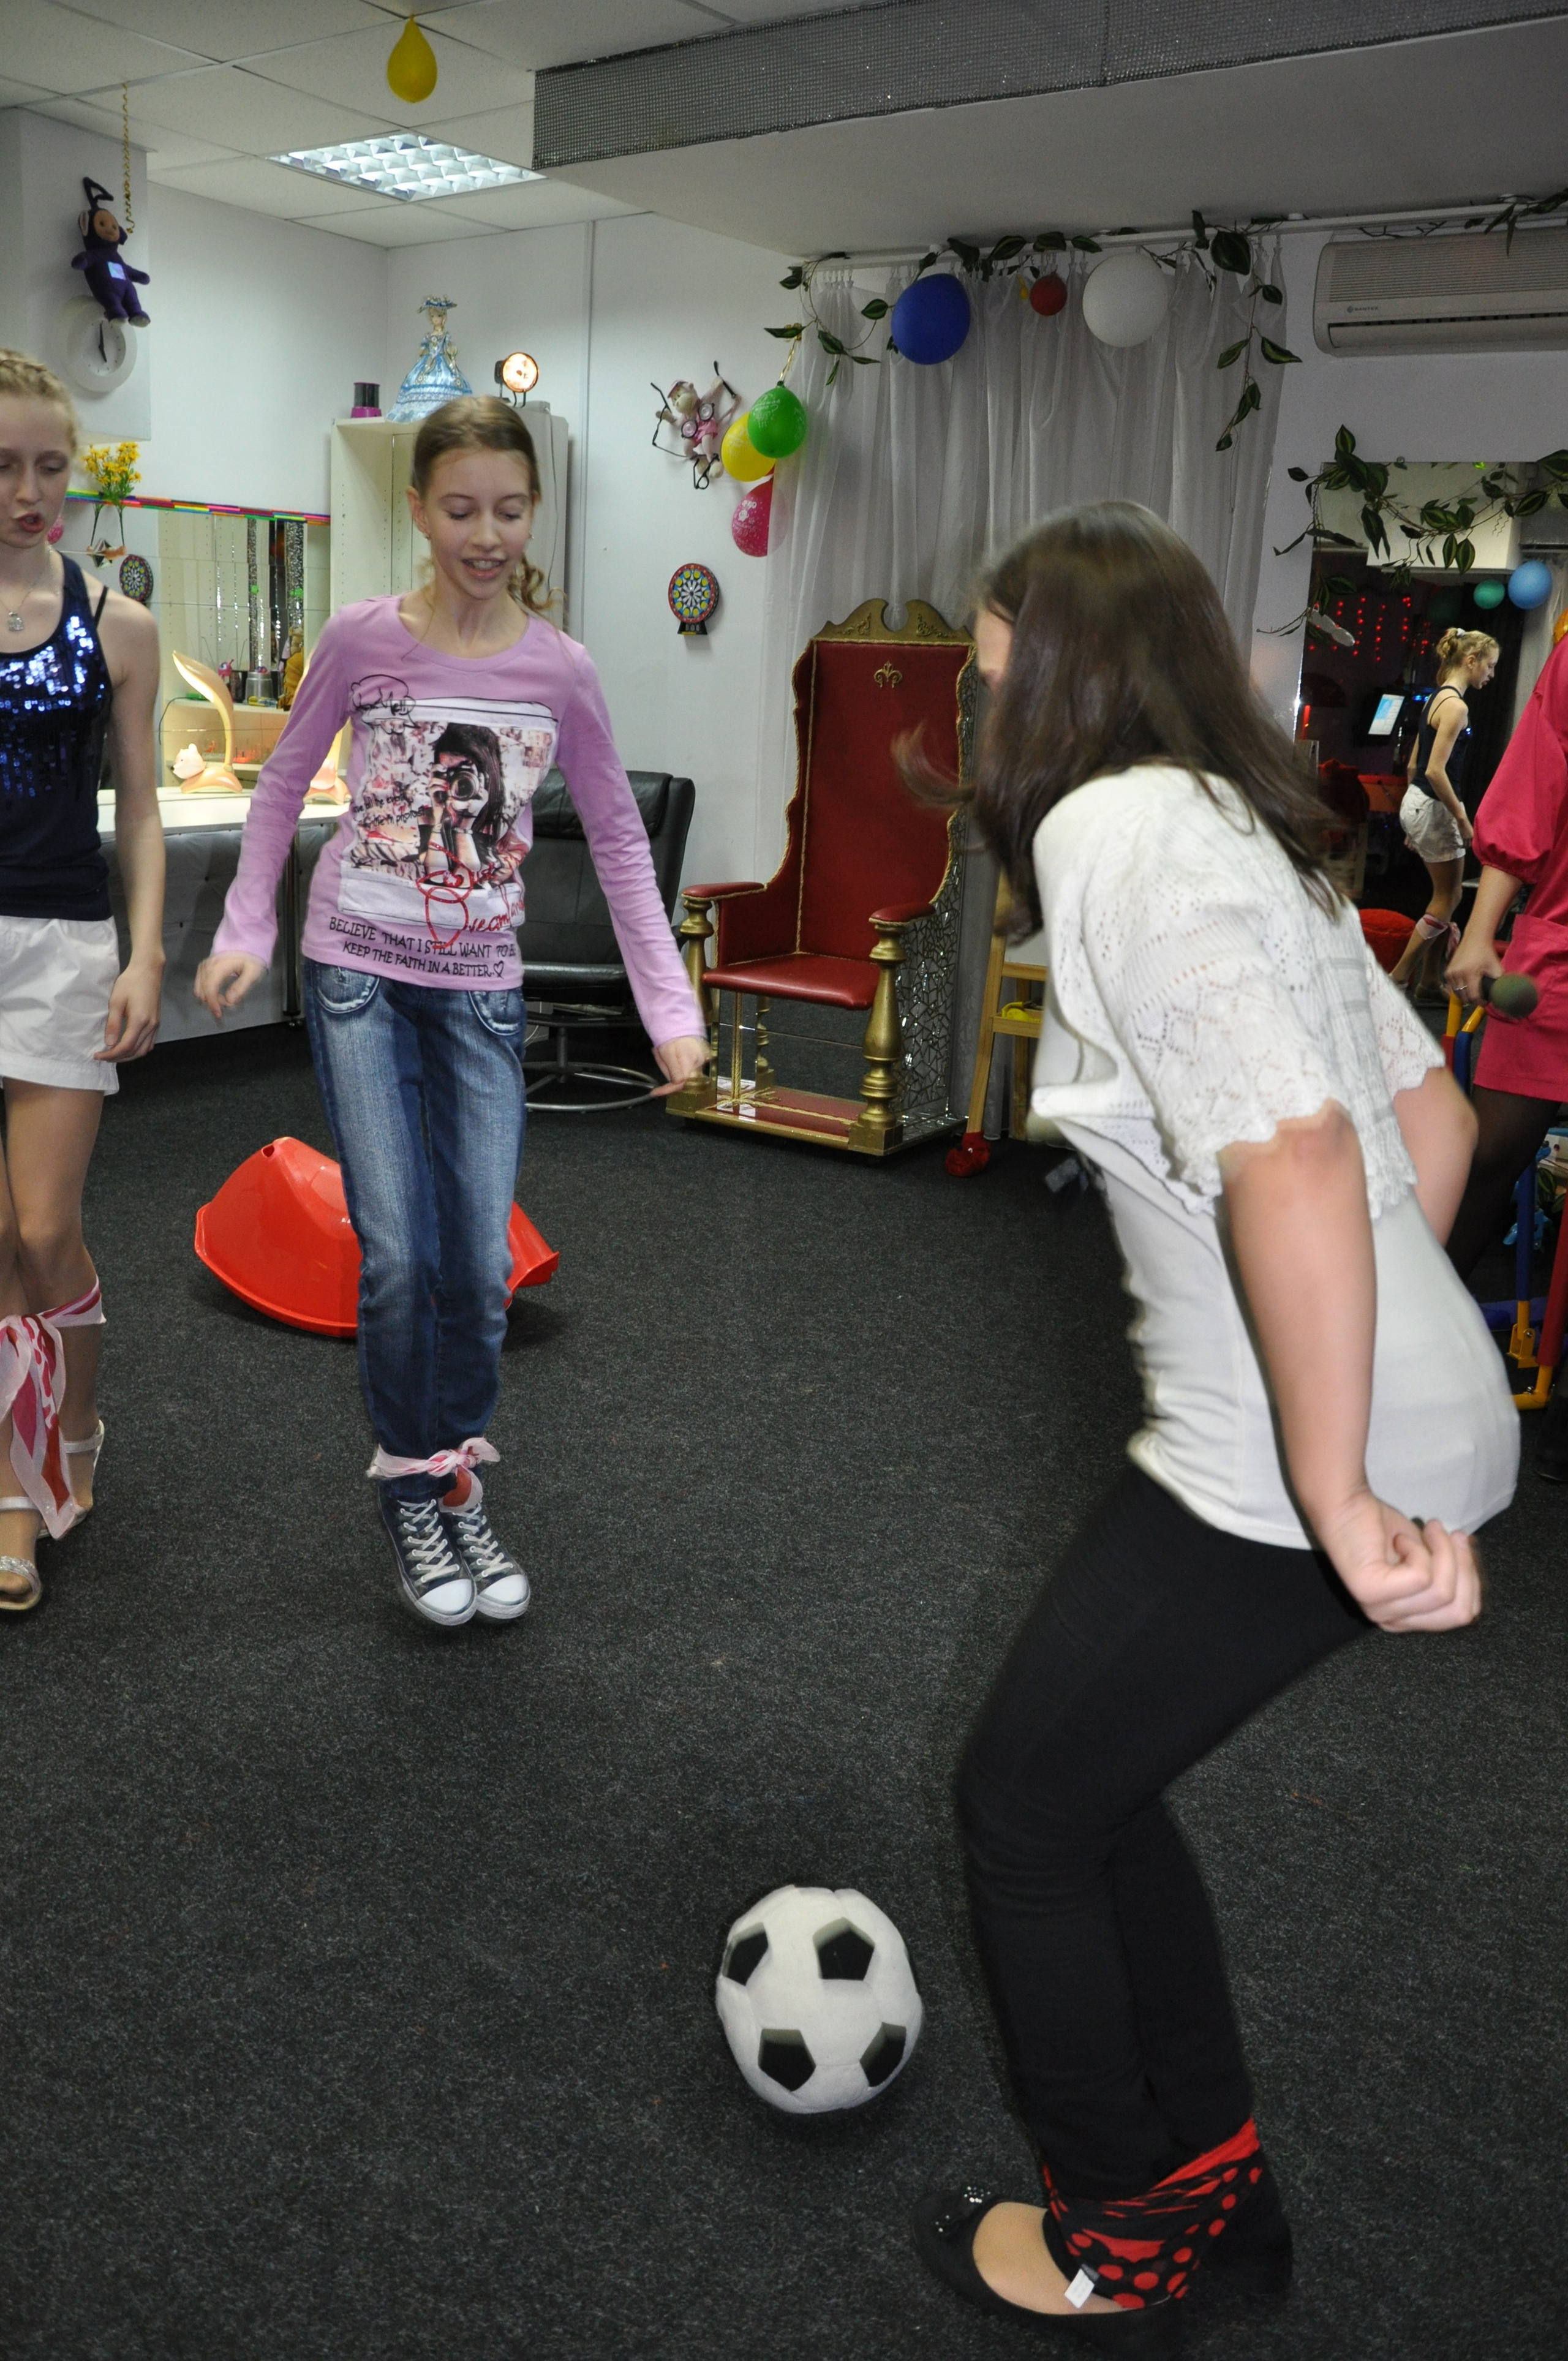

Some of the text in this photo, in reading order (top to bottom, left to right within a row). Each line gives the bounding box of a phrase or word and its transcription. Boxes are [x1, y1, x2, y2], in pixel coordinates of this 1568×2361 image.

[330, 916, 376, 941] BELIEVE
[382, 932, 415, 950] THAT
[418, 939, 422, 952] I
[425, 939, 457, 957] STILL
[459, 942, 492, 958] WANT
[497, 944, 508, 958] TO
[343, 941, 370, 956] KEEP
[372, 949, 393, 964] THE
[395, 954, 426, 971] FAITH
[428, 960, 440, 973] IN
[441, 962, 451, 974] A
